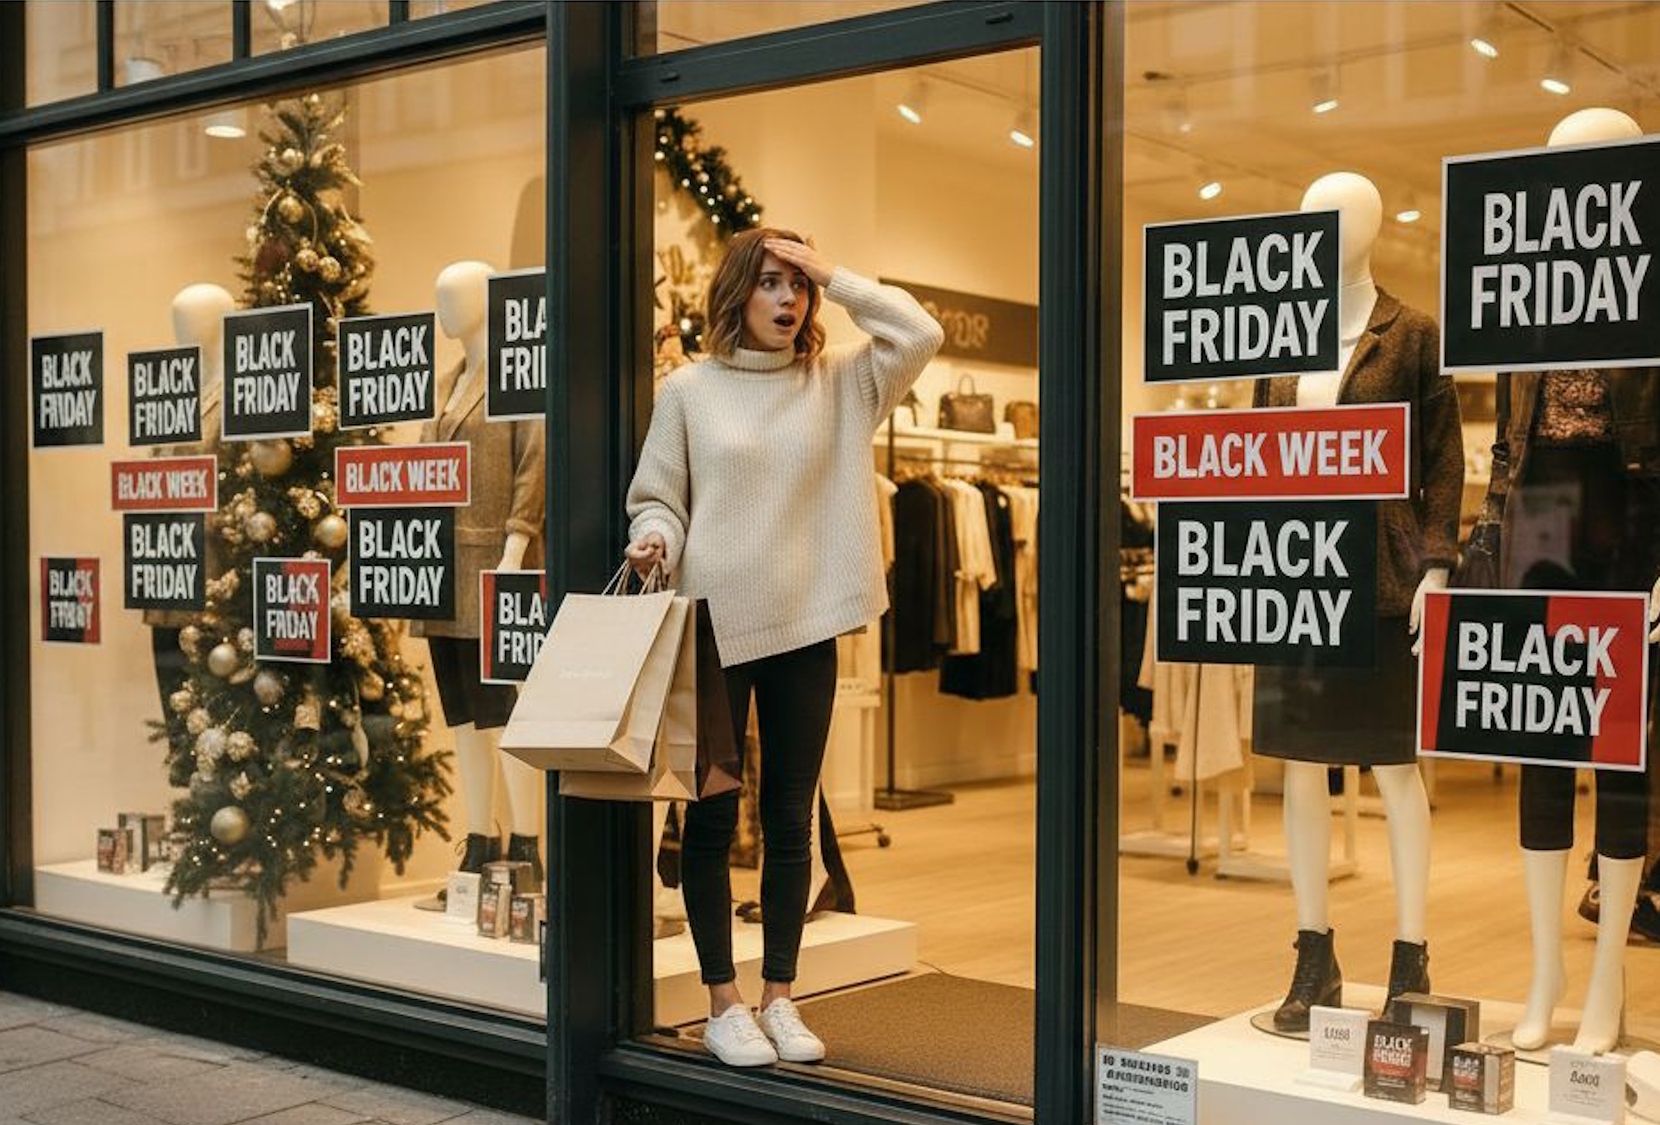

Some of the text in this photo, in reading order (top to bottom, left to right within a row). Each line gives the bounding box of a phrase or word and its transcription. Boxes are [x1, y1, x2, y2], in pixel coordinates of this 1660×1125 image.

[1484, 180, 1642, 255] BLACK
[1163, 230, 1324, 299] BLACK
[1471, 254, 1651, 329] FRIDAY
[235, 330, 296, 373] BLACK
[348, 325, 428, 372] BLACK
[1162, 300, 1329, 365] FRIDAY
[41, 351, 93, 389] BLACK
[134, 357, 195, 398] BLACK
[500, 345, 546, 391] FRI
[40, 389, 96, 429] FRIDAY
[233, 372, 300, 416] FRIDAY
[349, 370, 430, 417] FRIDAY
[134, 397, 197, 438] FRIDAY
[345, 458, 461, 493] BLACK WEEK
[1153, 429, 1389, 479] BLACK WEEK
[166, 469, 208, 498] WEEK
[131, 521, 197, 559] BLACK
[359, 519, 442, 559] BLACK
[1178, 519, 1349, 578] BLACK
[131, 563, 198, 600] FRIDAY
[265, 572, 320, 605] BLACK
[359, 565, 445, 606] FRIDAY
[499, 592, 548, 626] BLA
[1177, 586, 1352, 646] FRIDAY
[1457, 621, 1619, 678] BLACK
[1455, 680, 1611, 737] FRIDAY
